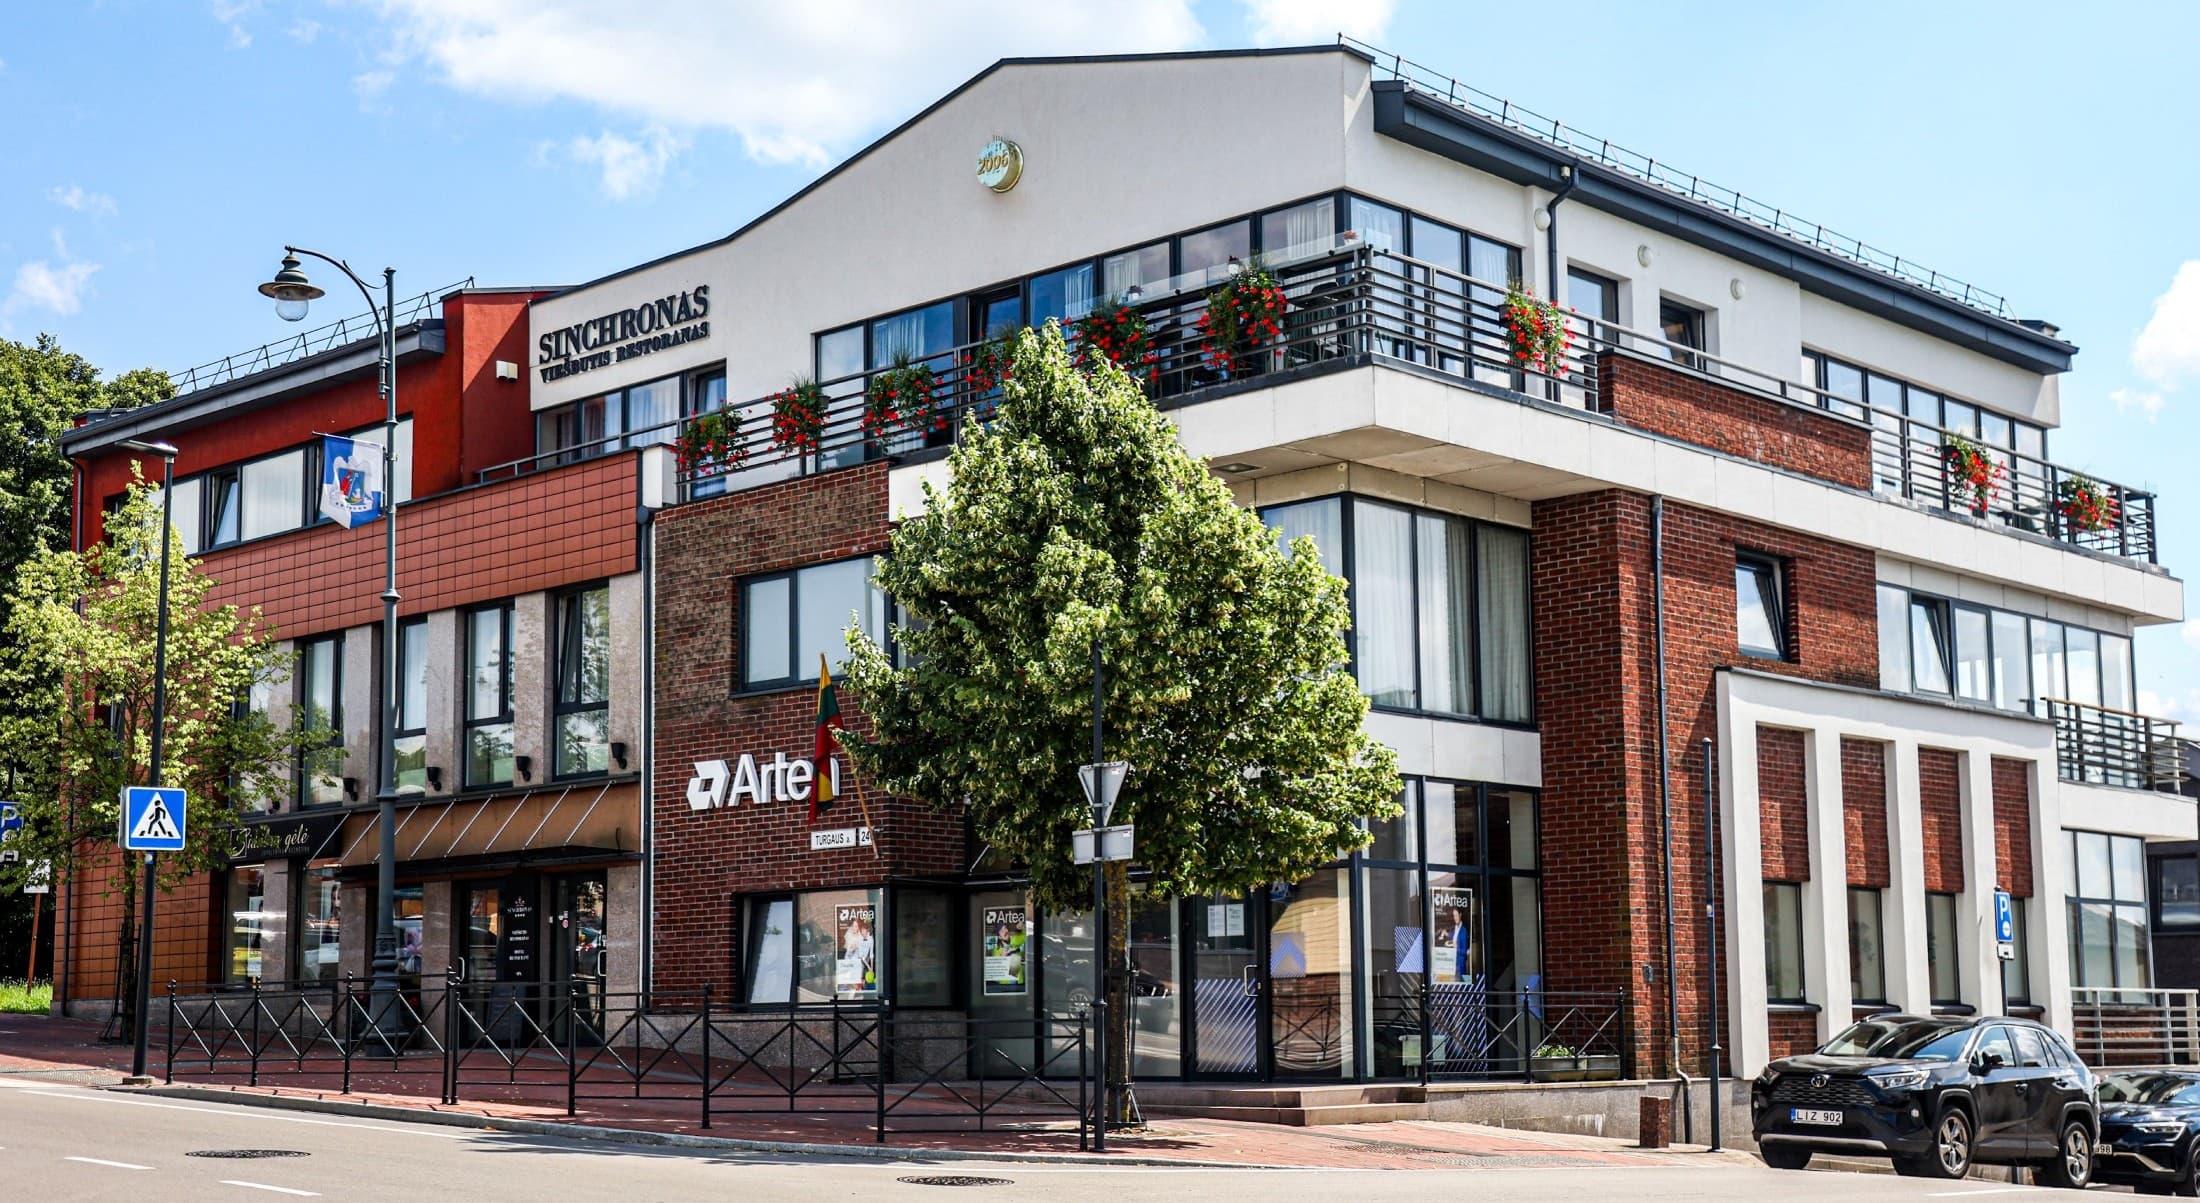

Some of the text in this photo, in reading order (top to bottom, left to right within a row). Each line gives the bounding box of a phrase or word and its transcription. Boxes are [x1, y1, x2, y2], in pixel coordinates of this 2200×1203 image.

[539, 284, 710, 364] SINCHRONAS
[540, 321, 710, 383] VIEŠBUTIS RESTORANAS
[284, 823, 309, 853] gėlė
[815, 833, 844, 845] TURGAUS
[1443, 893, 1468, 908] Artea
[2000, 896, 2008, 920] P
[849, 908, 875, 920] Artea
[997, 910, 1025, 924] Artea
[1796, 1111, 1841, 1122] LIZ 902
